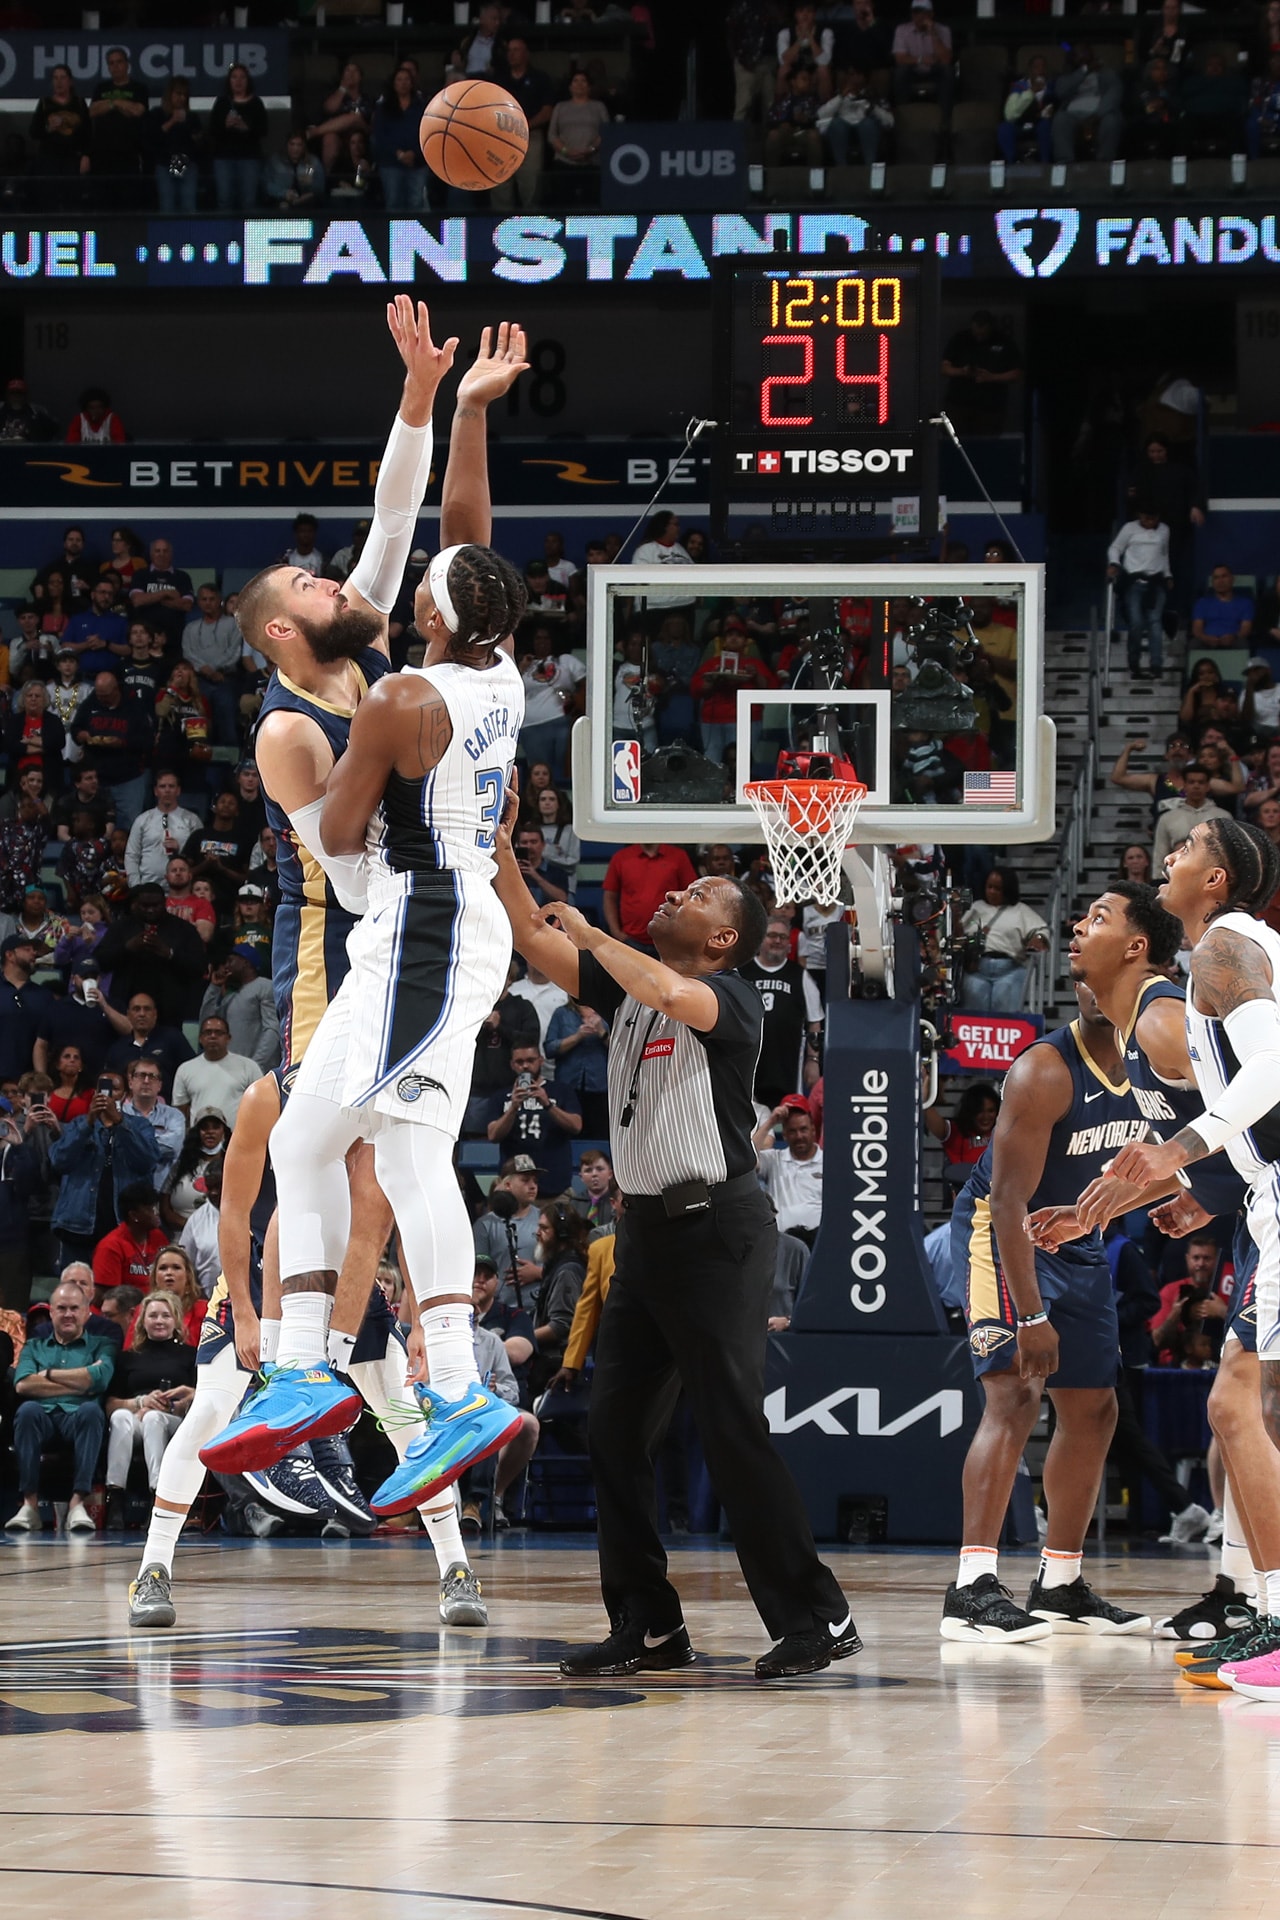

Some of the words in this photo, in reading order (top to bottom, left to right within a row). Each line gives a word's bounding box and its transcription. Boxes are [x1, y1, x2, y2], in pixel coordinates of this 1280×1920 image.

[139, 44, 268, 79] CLUB
[660, 150, 735, 177] HUB
[243, 217, 467, 284] FAN
[492, 214, 869, 283] STAND
[772, 278, 900, 328] 12:00
[761, 333, 888, 426] 24
[130, 461, 436, 487] BETRIVE
[628, 458, 711, 484] BE
[785, 449, 913, 473] TISSOT
[464, 707, 508, 761] CARTER
[475, 759, 515, 850] 3
[616, 788, 631, 800] NBA
[755, 979, 792, 995] EHIGH
[958, 1024, 993, 1042] GET
[996, 1027, 1021, 1044] UP
[644, 1043, 672, 1056] Emirates
[965, 1042, 1015, 1061] Y'ALL
[518, 1113, 541, 1139] 14
[1066, 1124, 1108, 1156] NEW
